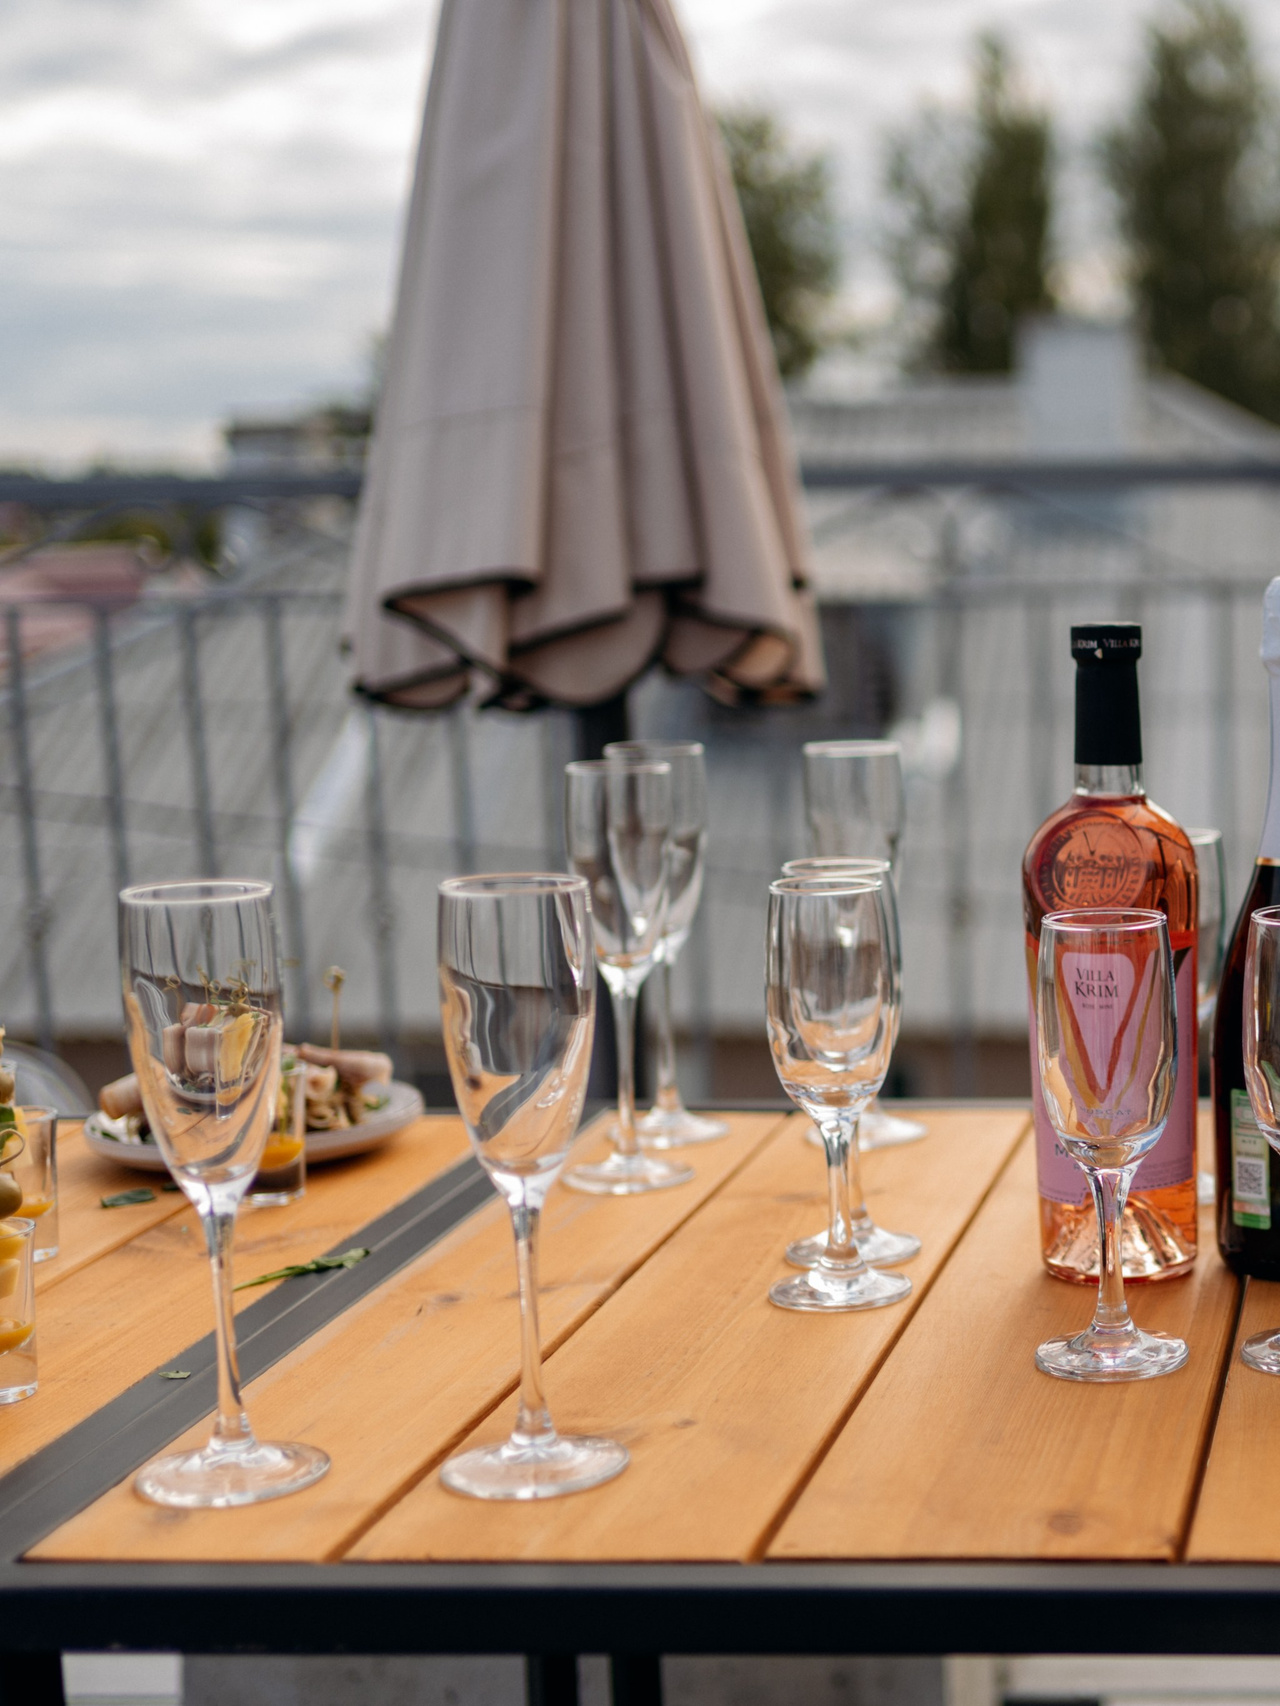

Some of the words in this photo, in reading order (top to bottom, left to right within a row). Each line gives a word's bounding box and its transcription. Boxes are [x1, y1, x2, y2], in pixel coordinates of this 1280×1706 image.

[1076, 967, 1114, 982] VILLA
[1074, 980, 1119, 998] KRIM
[1080, 1105, 1132, 1116] MUSCAT
